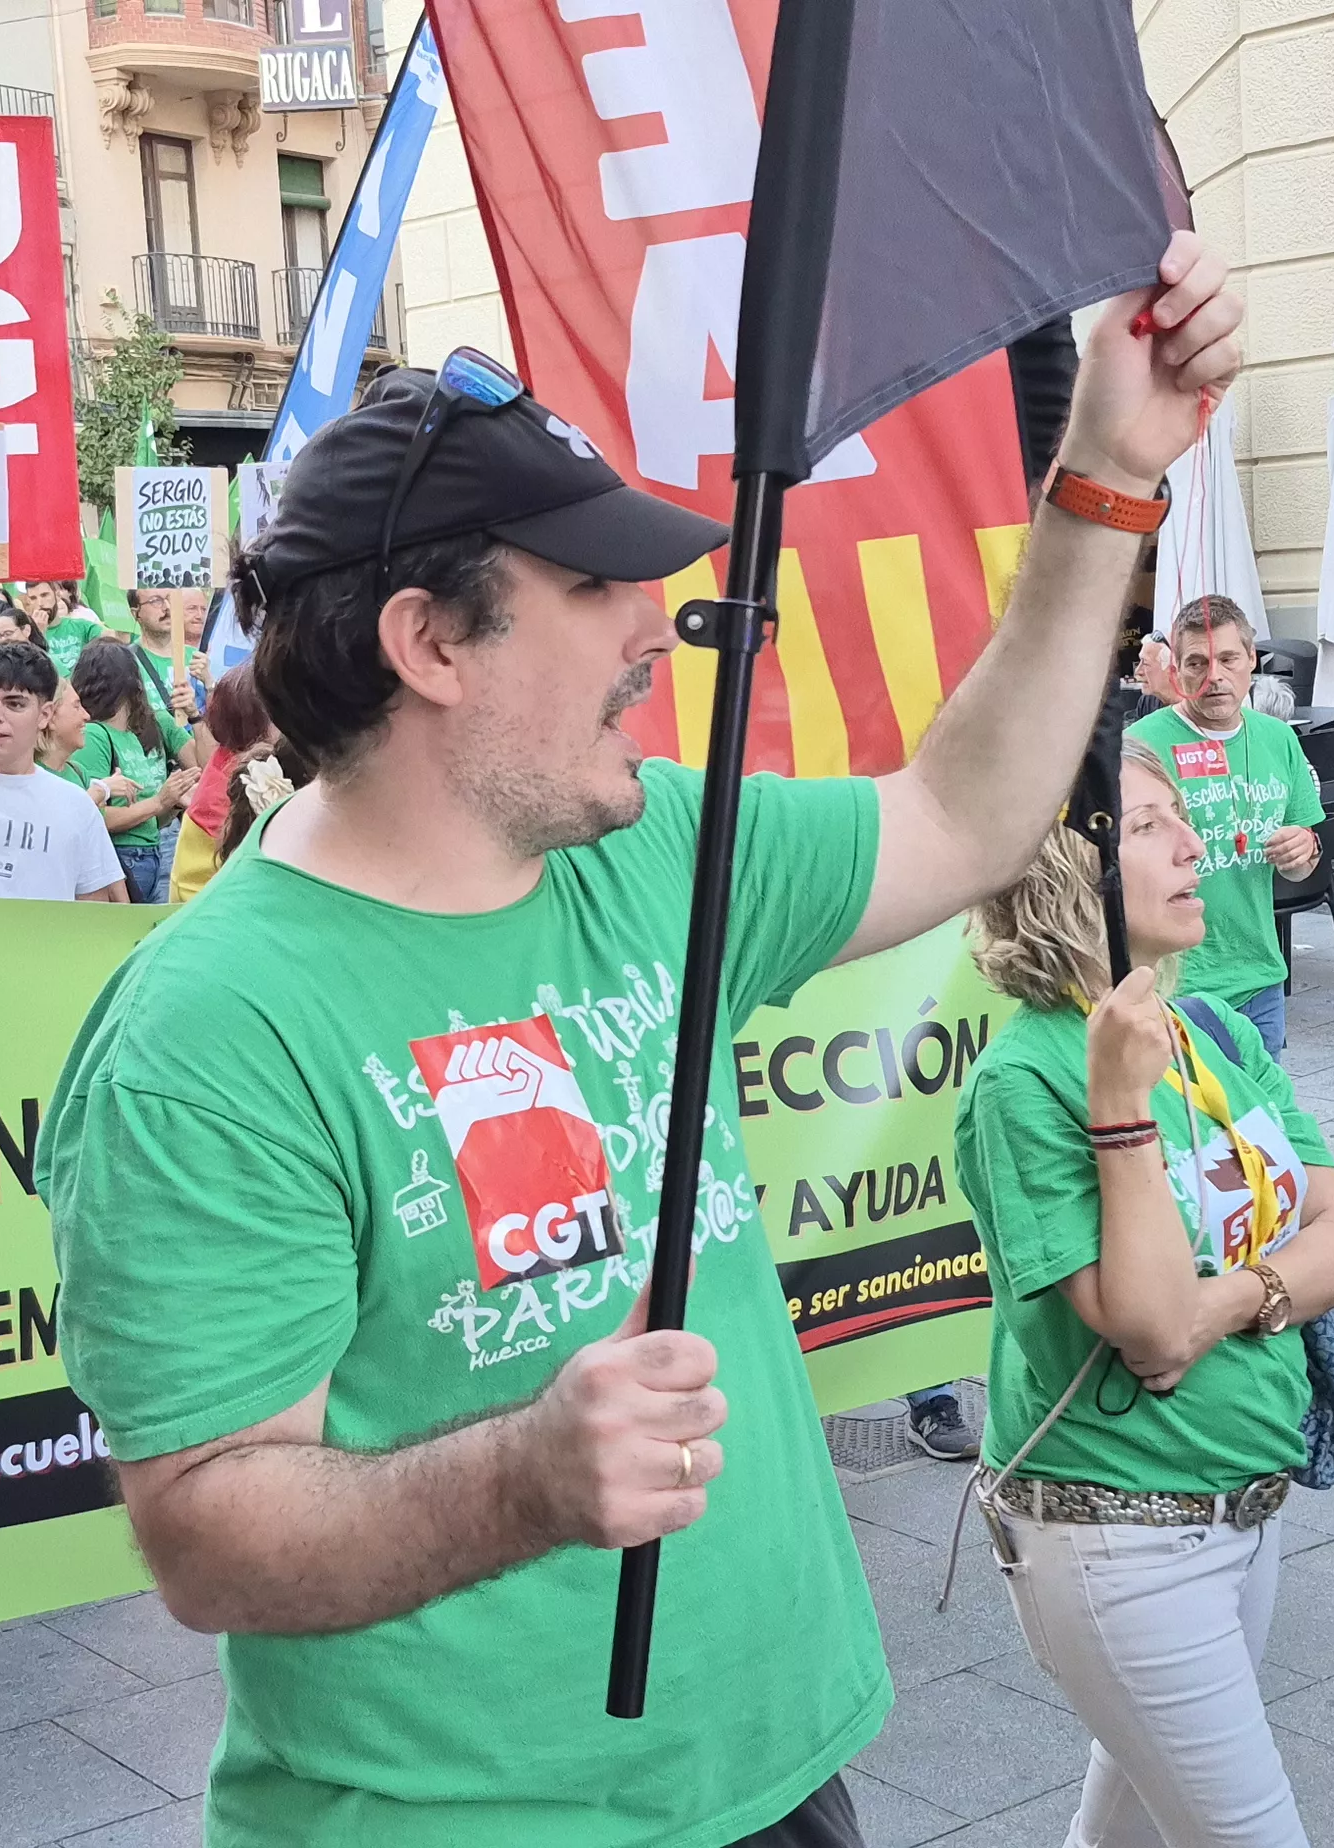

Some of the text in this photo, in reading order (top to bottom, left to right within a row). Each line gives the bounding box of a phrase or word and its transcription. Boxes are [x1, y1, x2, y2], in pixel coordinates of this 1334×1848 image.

[260, 50, 355, 103] RUGACA
[138, 478, 207, 509] SERGIO,
[142, 505, 206, 532] NO ESTÁS
[145, 532, 193, 556] SOLO
[1176, 751, 1204, 765] UGT
[1183, 778, 1288, 809] ESCUELA PÚBLICA
[1201, 824, 1224, 843] DE
[788, 1155, 948, 1237] AYUDA
[488, 1189, 610, 1273] CGT
[463, 1257, 631, 1352] PARA
[810, 1283, 851, 1316] ser
[469, 1334, 552, 1371] Huesca
